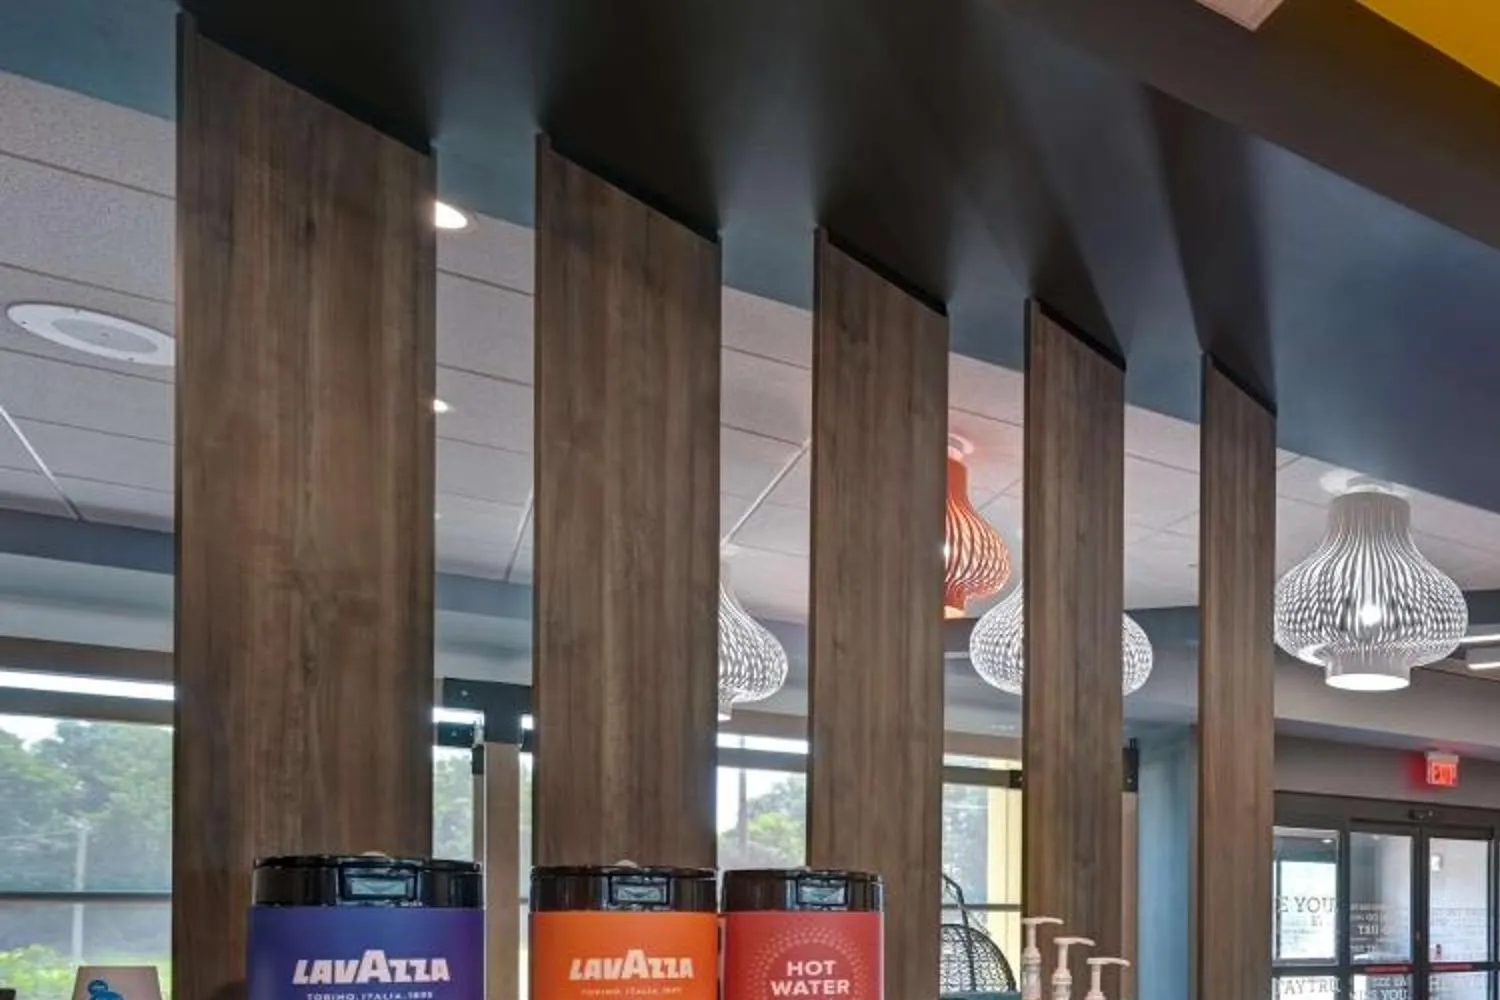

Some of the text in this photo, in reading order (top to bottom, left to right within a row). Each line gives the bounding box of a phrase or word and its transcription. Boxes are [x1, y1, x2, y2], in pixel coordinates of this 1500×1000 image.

[292, 949, 451, 985] LAVAZZA
[568, 949, 695, 981] LAVAZZA
[786, 960, 837, 977] HOT
[770, 979, 851, 996] WATER
